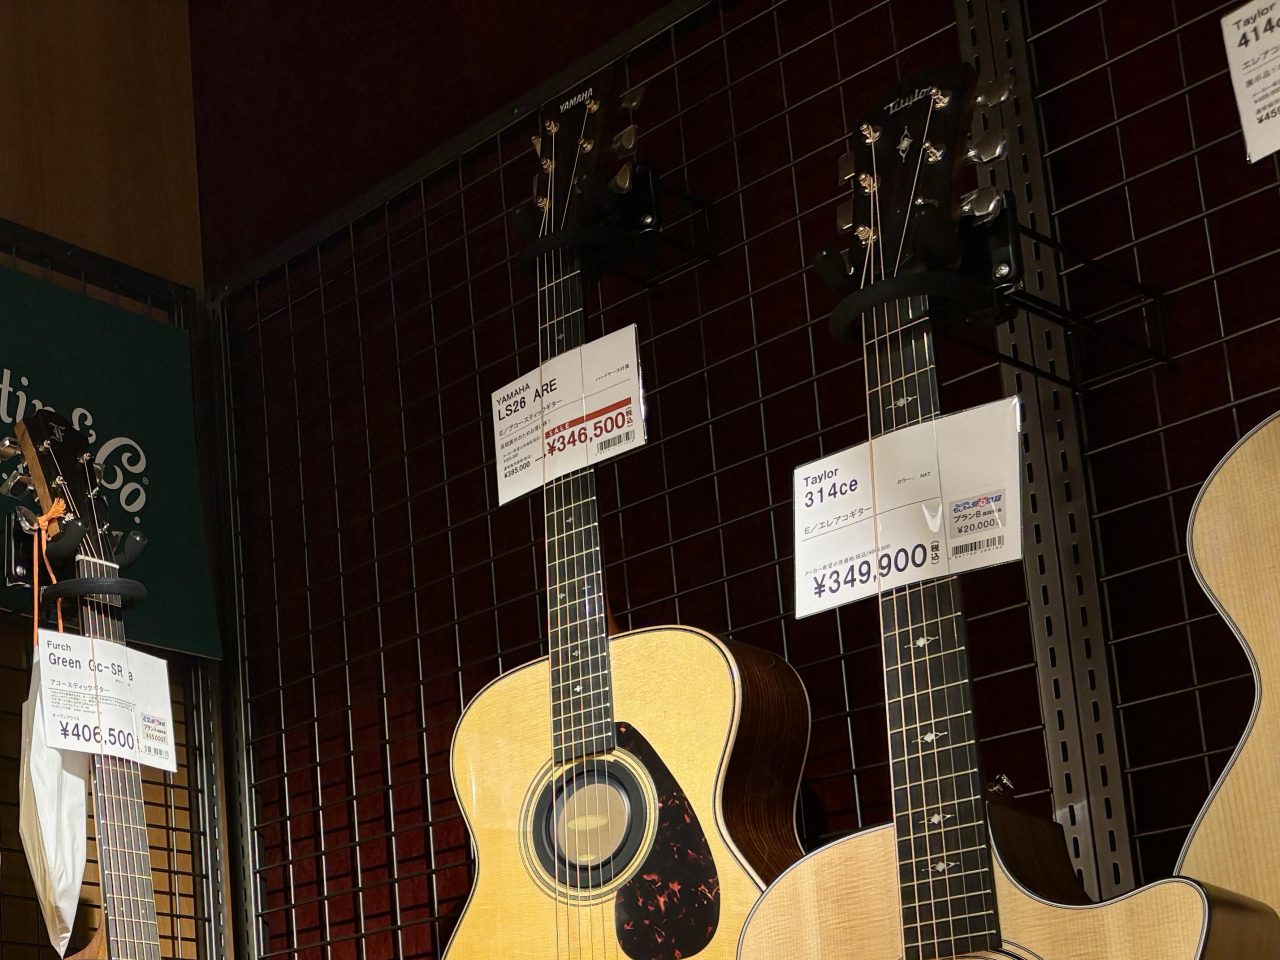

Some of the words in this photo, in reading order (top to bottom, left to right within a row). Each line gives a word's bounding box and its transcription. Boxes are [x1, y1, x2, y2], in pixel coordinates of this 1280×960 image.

[1233, 3, 1276, 30] Taylor
[559, 88, 593, 113] YAMAHA
[496, 383, 530, 406] YAMAHA
[498, 397, 526, 421] LS26
[533, 378, 558, 402] ARE
[547, 412, 626, 456] ¥346,500
[550, 423, 570, 436] SALE
[803, 468, 839, 488] Taylor
[804, 478, 858, 508] 314ce
[812, 543, 927, 598] ¥349,900
[47, 640, 72, 652] Furch
[48, 653, 82, 669] Green
[128, 672, 133, 682] a
[60, 721, 134, 750] ¥406,500
